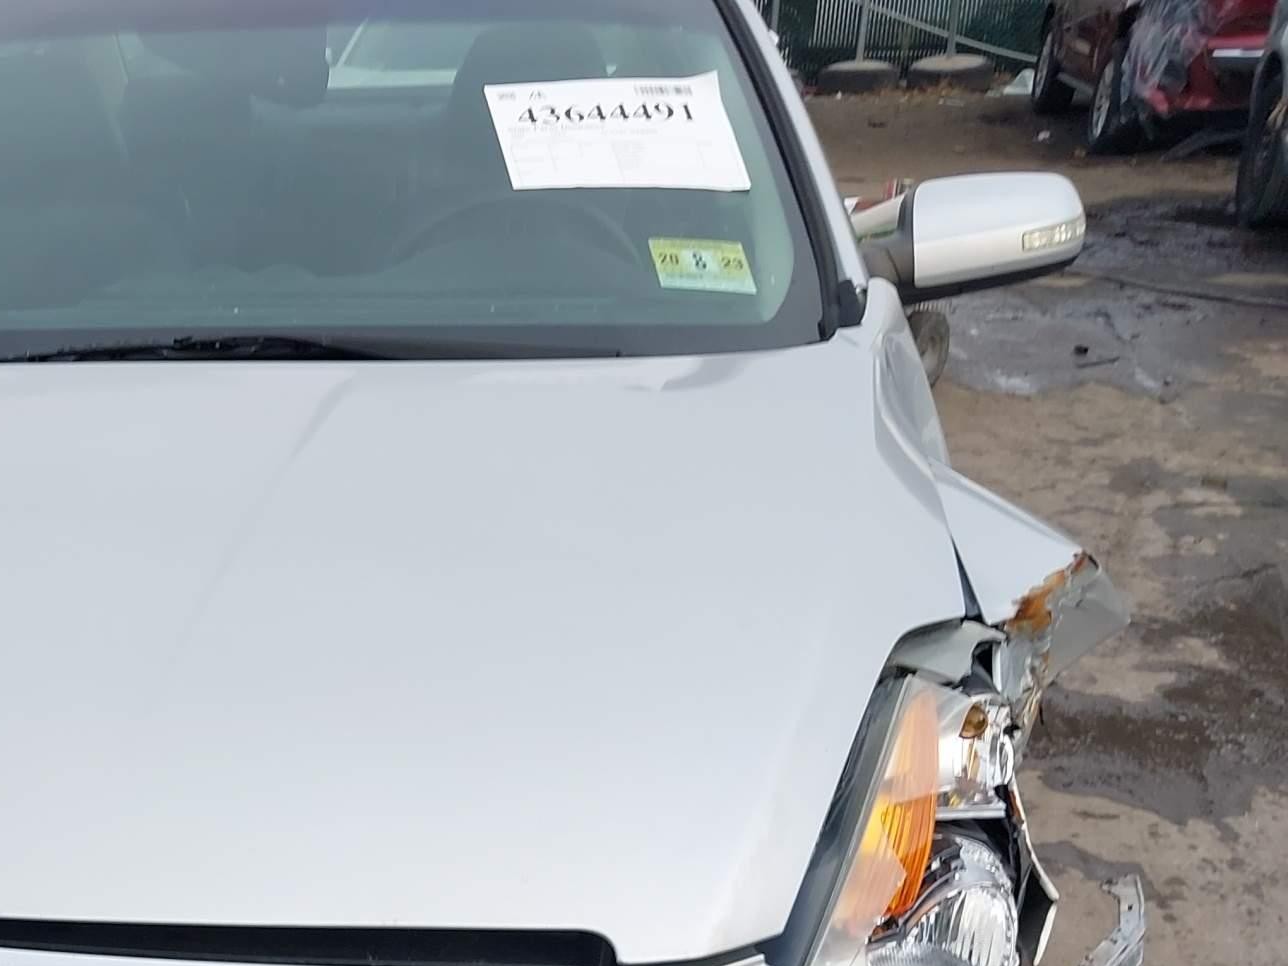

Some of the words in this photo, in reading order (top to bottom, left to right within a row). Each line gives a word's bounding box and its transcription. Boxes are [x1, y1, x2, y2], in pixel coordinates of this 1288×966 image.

[517, 102, 694, 126] 43644491
[657, 252, 680, 265] 20
[720, 256, 744, 270] 23
